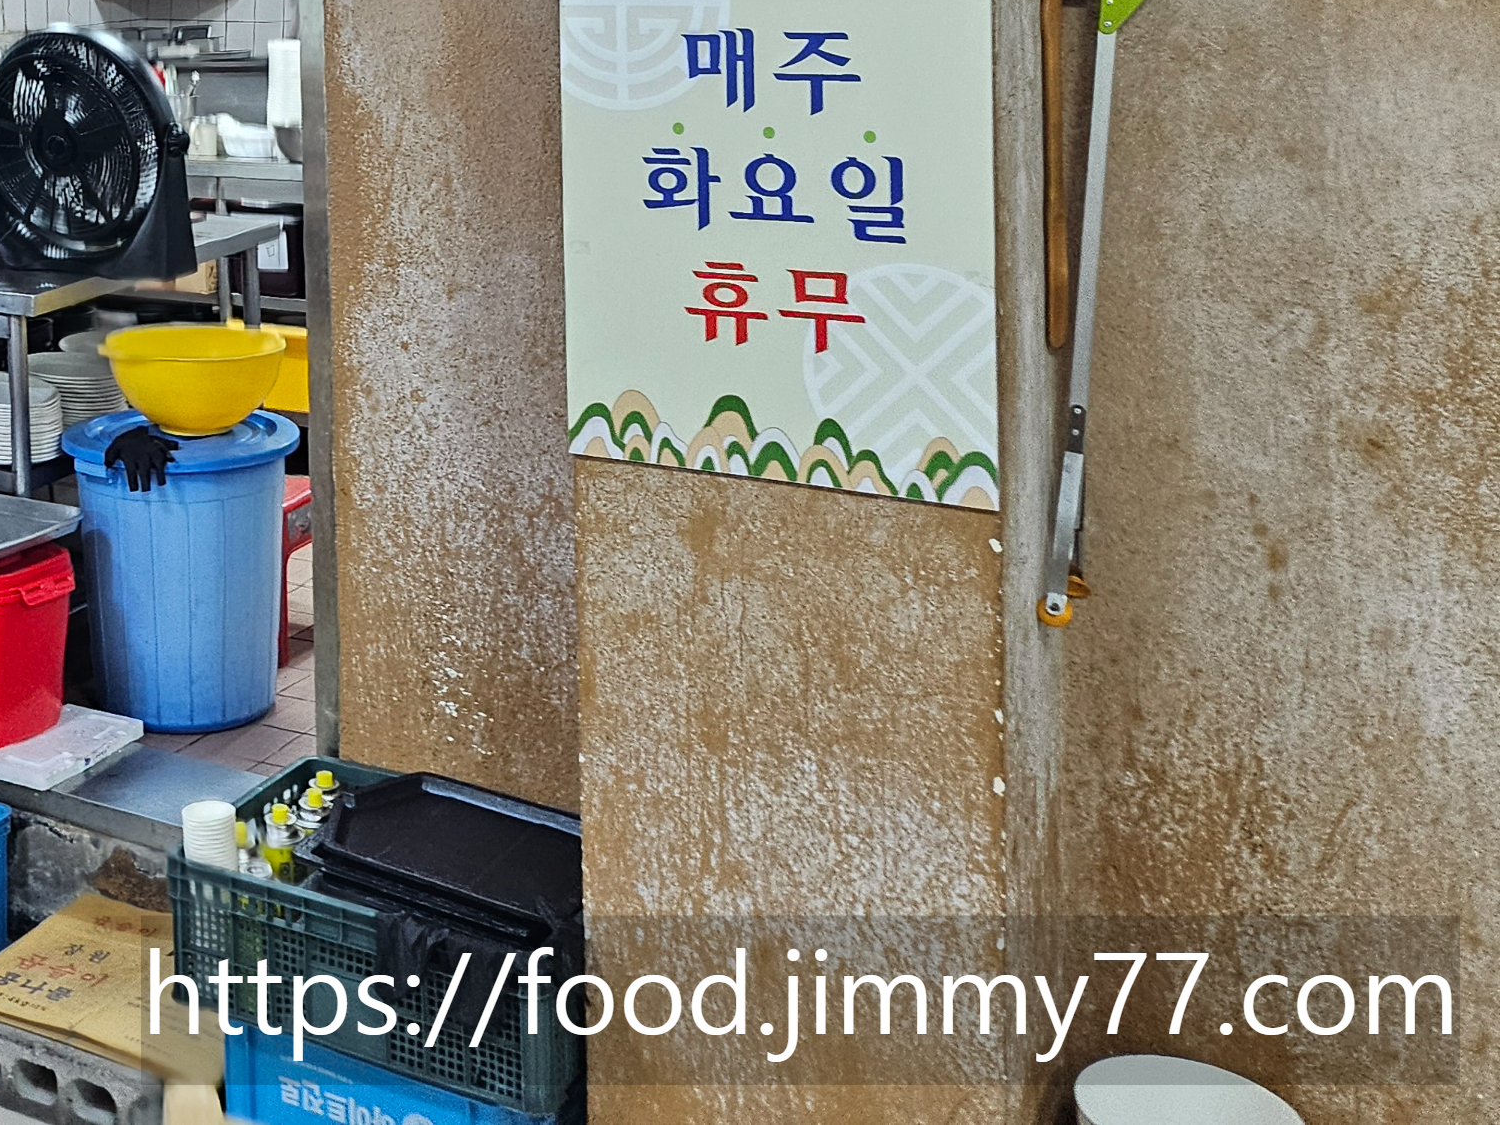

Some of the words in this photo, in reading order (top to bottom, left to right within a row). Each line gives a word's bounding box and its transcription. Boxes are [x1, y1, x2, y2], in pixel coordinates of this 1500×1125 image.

[680, 27, 862, 116] 매주
[642, 146, 907, 245] 화요일
[684, 261, 866, 355] 휴무
